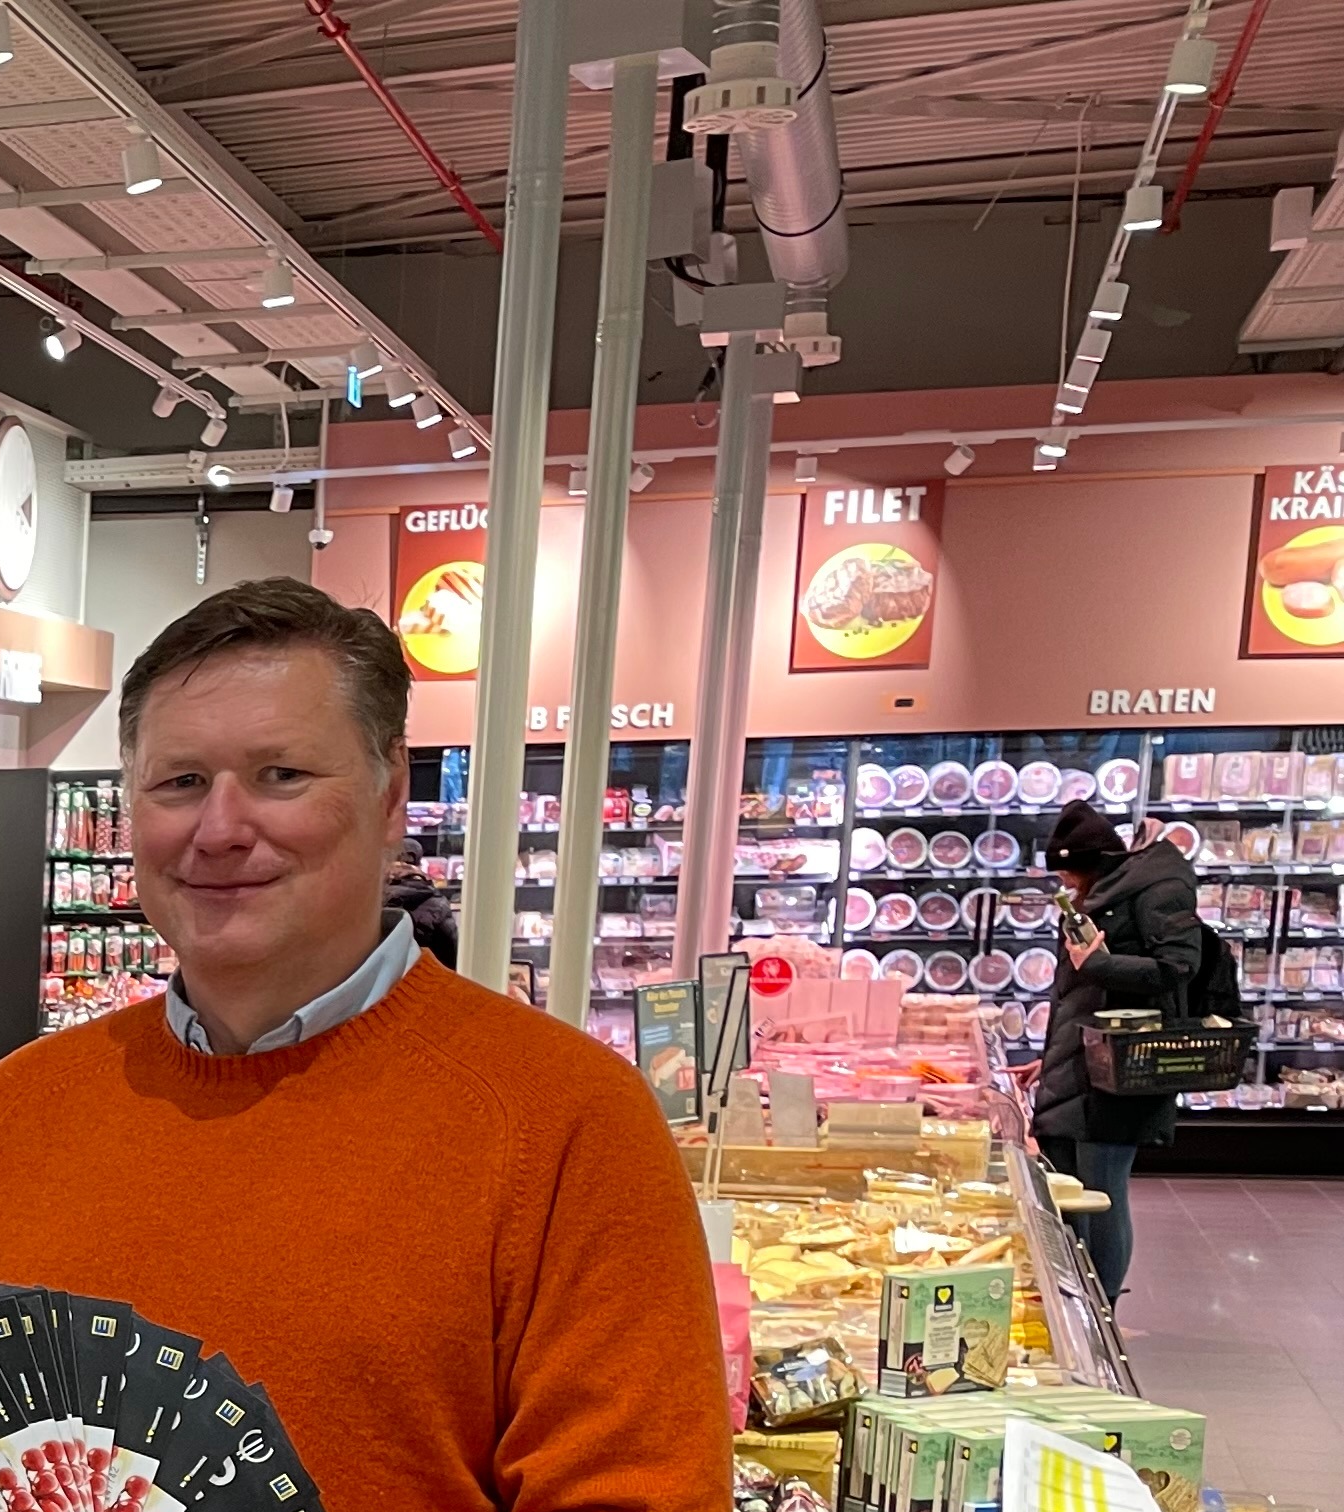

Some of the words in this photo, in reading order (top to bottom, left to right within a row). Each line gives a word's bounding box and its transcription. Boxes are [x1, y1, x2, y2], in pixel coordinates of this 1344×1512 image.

[823, 487, 928, 525] FILET
[1270, 497, 1344, 521] KRAI
[1089, 688, 1216, 715] BRATEN
[526, 706, 548, 731] B
